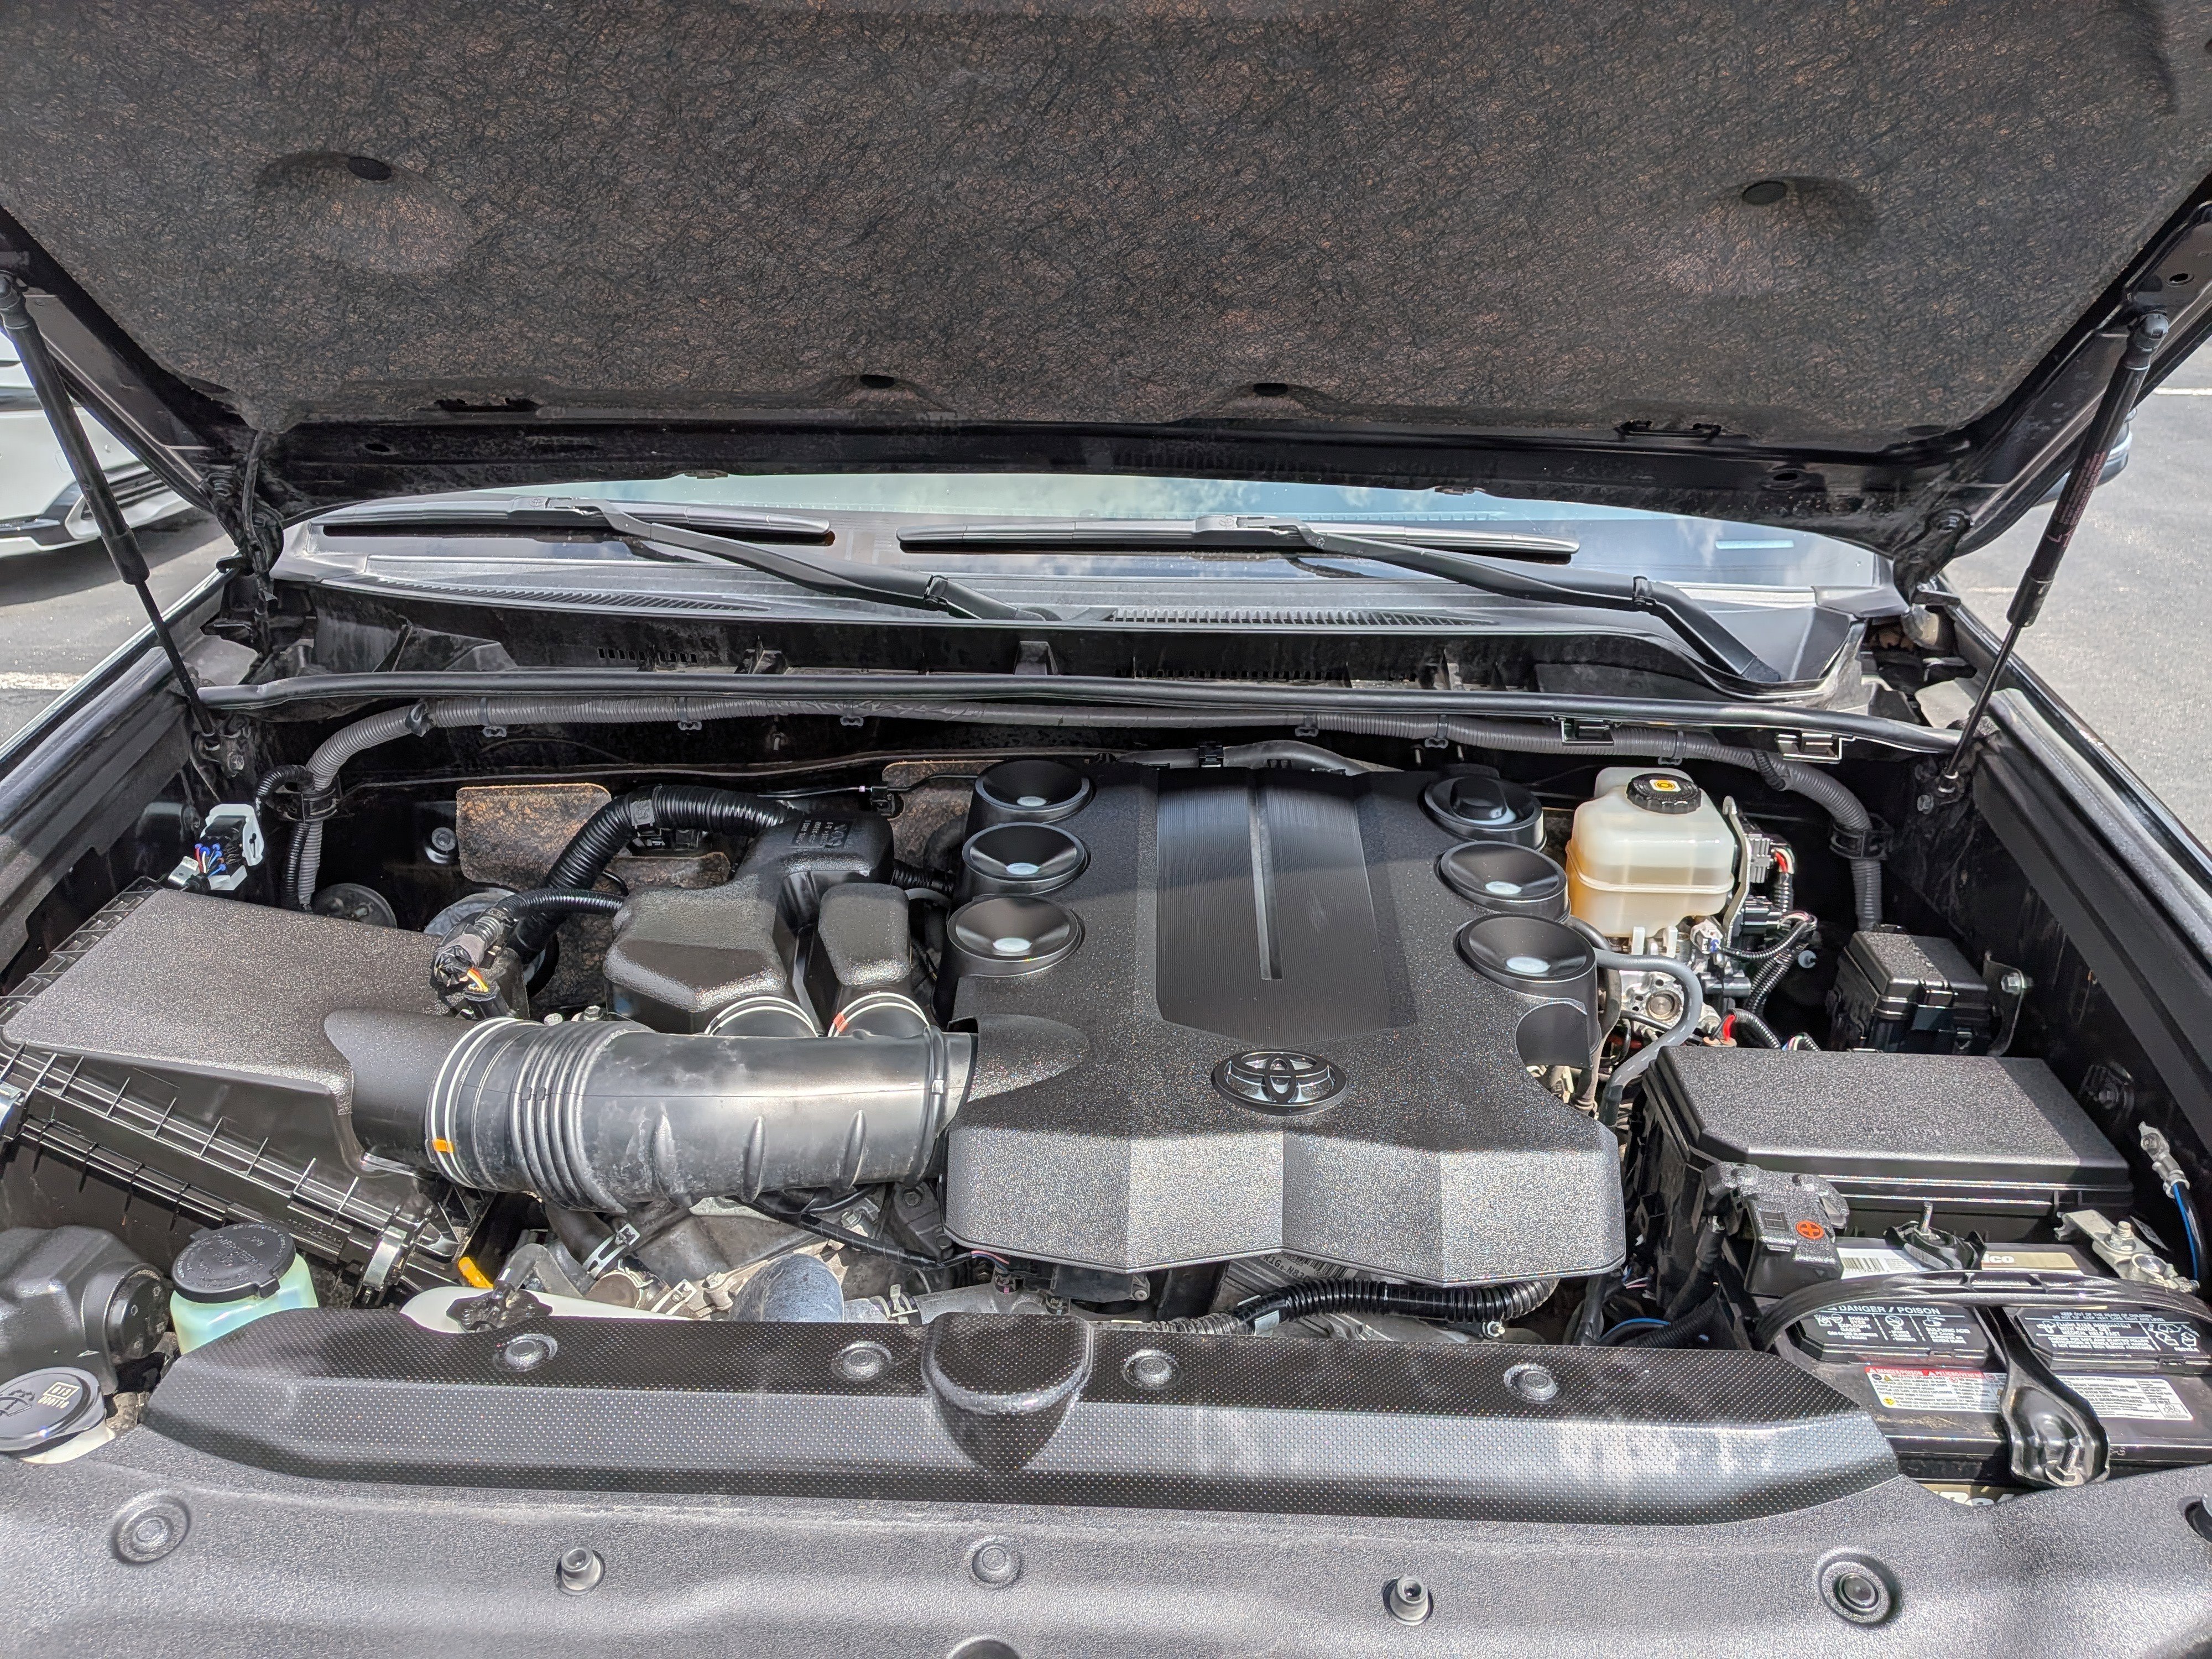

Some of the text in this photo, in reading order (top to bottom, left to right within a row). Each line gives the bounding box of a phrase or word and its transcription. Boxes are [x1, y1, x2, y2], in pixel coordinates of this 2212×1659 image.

[1983, 1253, 2015, 1264] lco
[1839, 1305, 1886, 1313] DANGER
[1897, 1306, 1941, 1315] POISON
